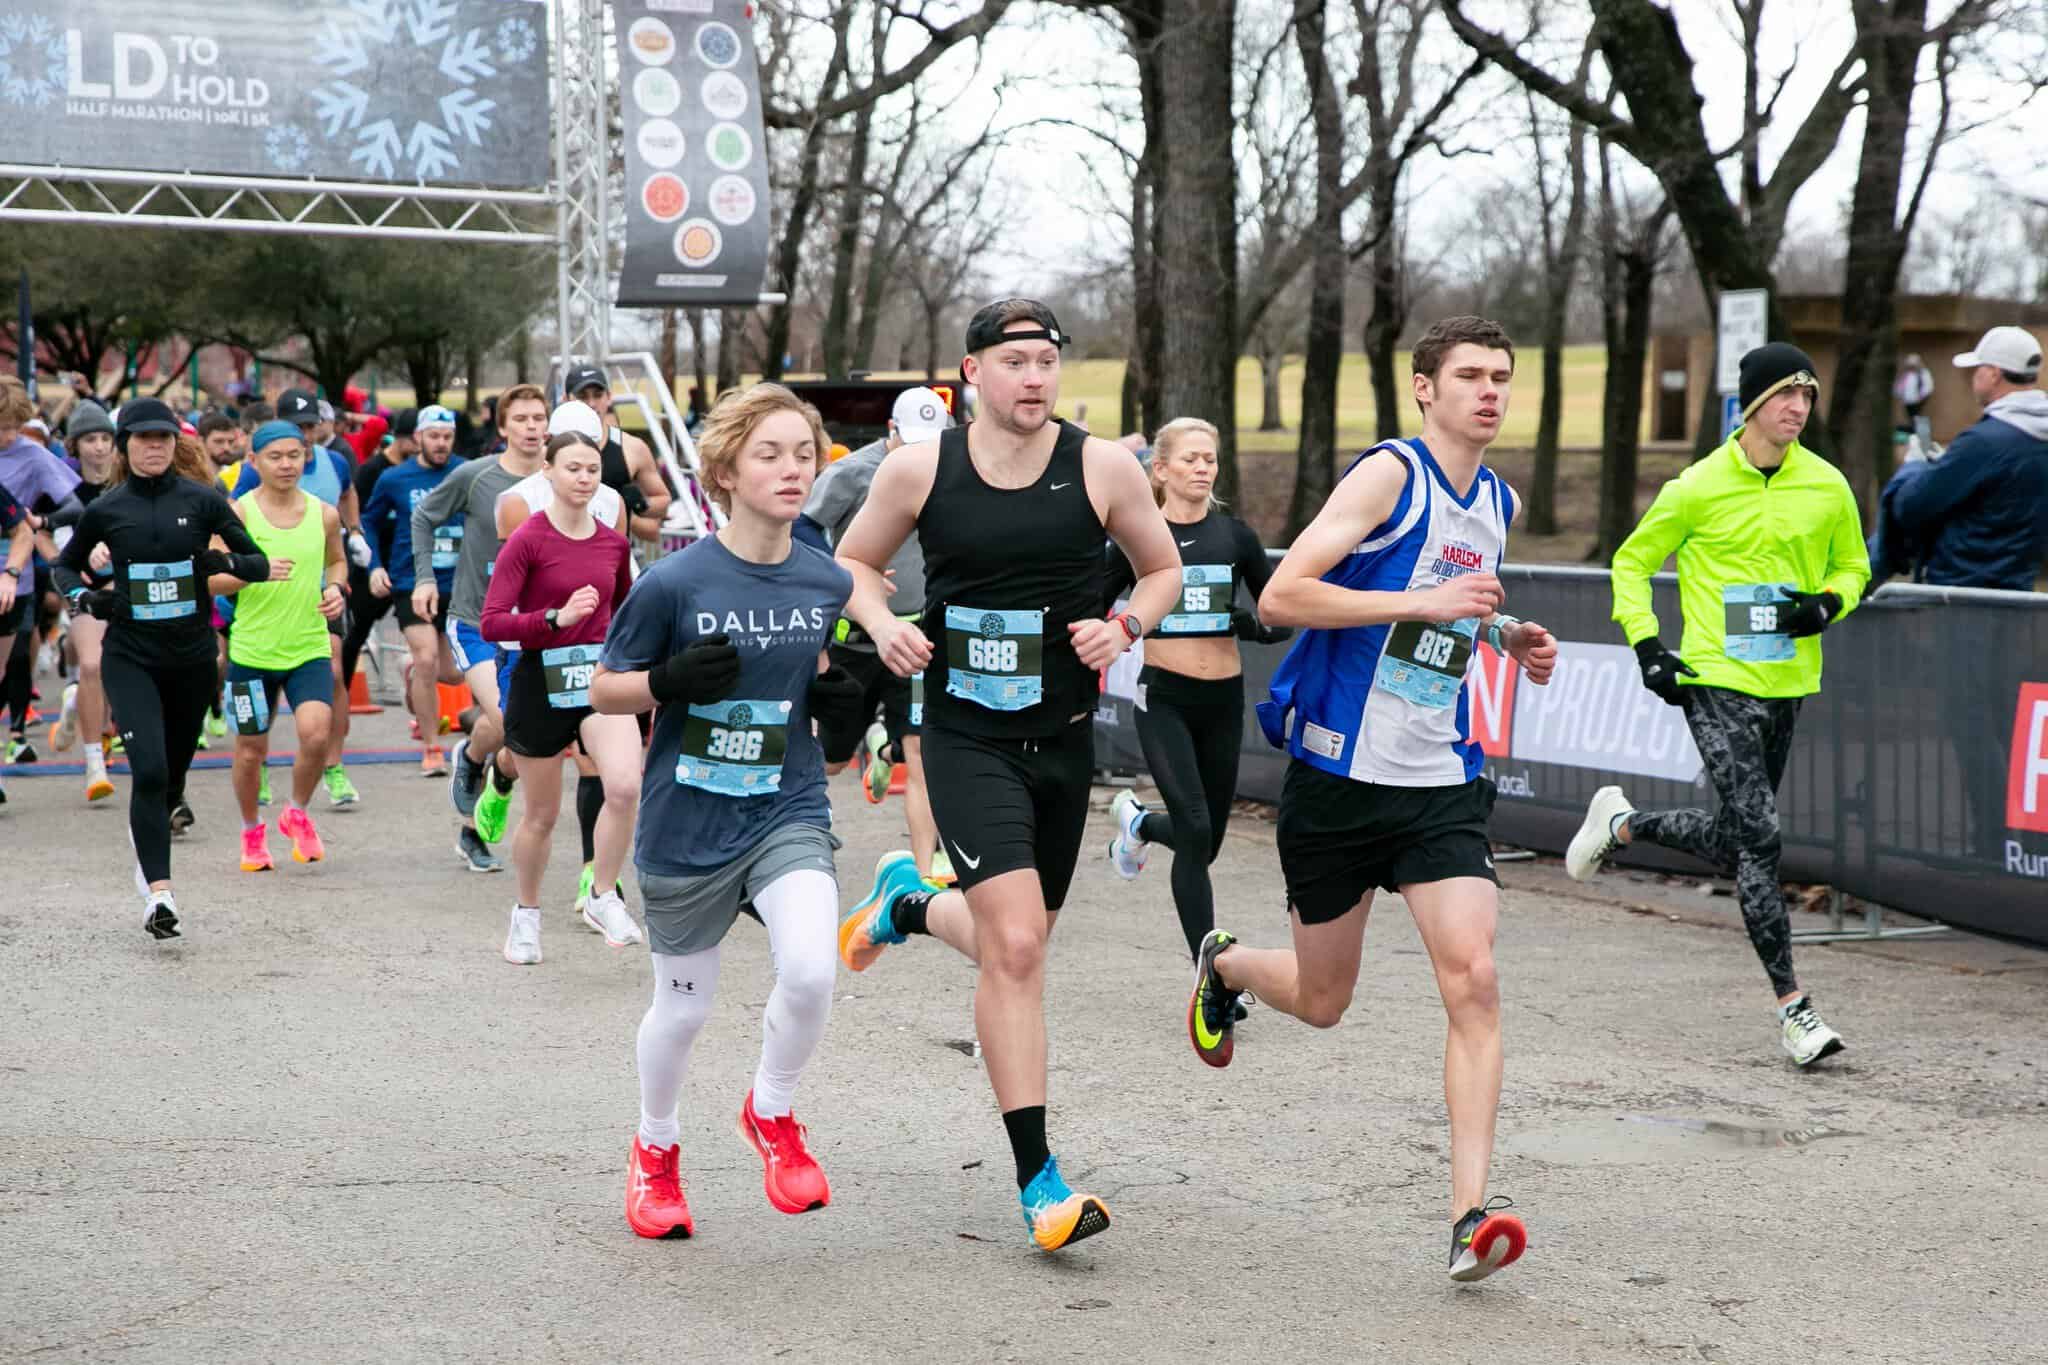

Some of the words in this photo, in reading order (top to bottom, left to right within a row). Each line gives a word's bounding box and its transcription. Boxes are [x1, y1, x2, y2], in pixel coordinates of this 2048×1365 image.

[170, 35, 219, 66] TO
[173, 74, 270, 108] HOLD
[66, 100, 109, 116] HALF
[111, 103, 203, 122] MARATHON
[251, 112, 271, 127] 5K
[1442, 543, 1484, 569] HARLEM
[147, 580, 179, 603] 912
[1184, 586, 1211, 612] 55
[696, 607, 824, 635] DALLAS
[1749, 605, 1778, 632] 56
[967, 637, 1019, 673] 688
[1413, 628, 1456, 669] 813
[706, 727, 764, 760] 386
